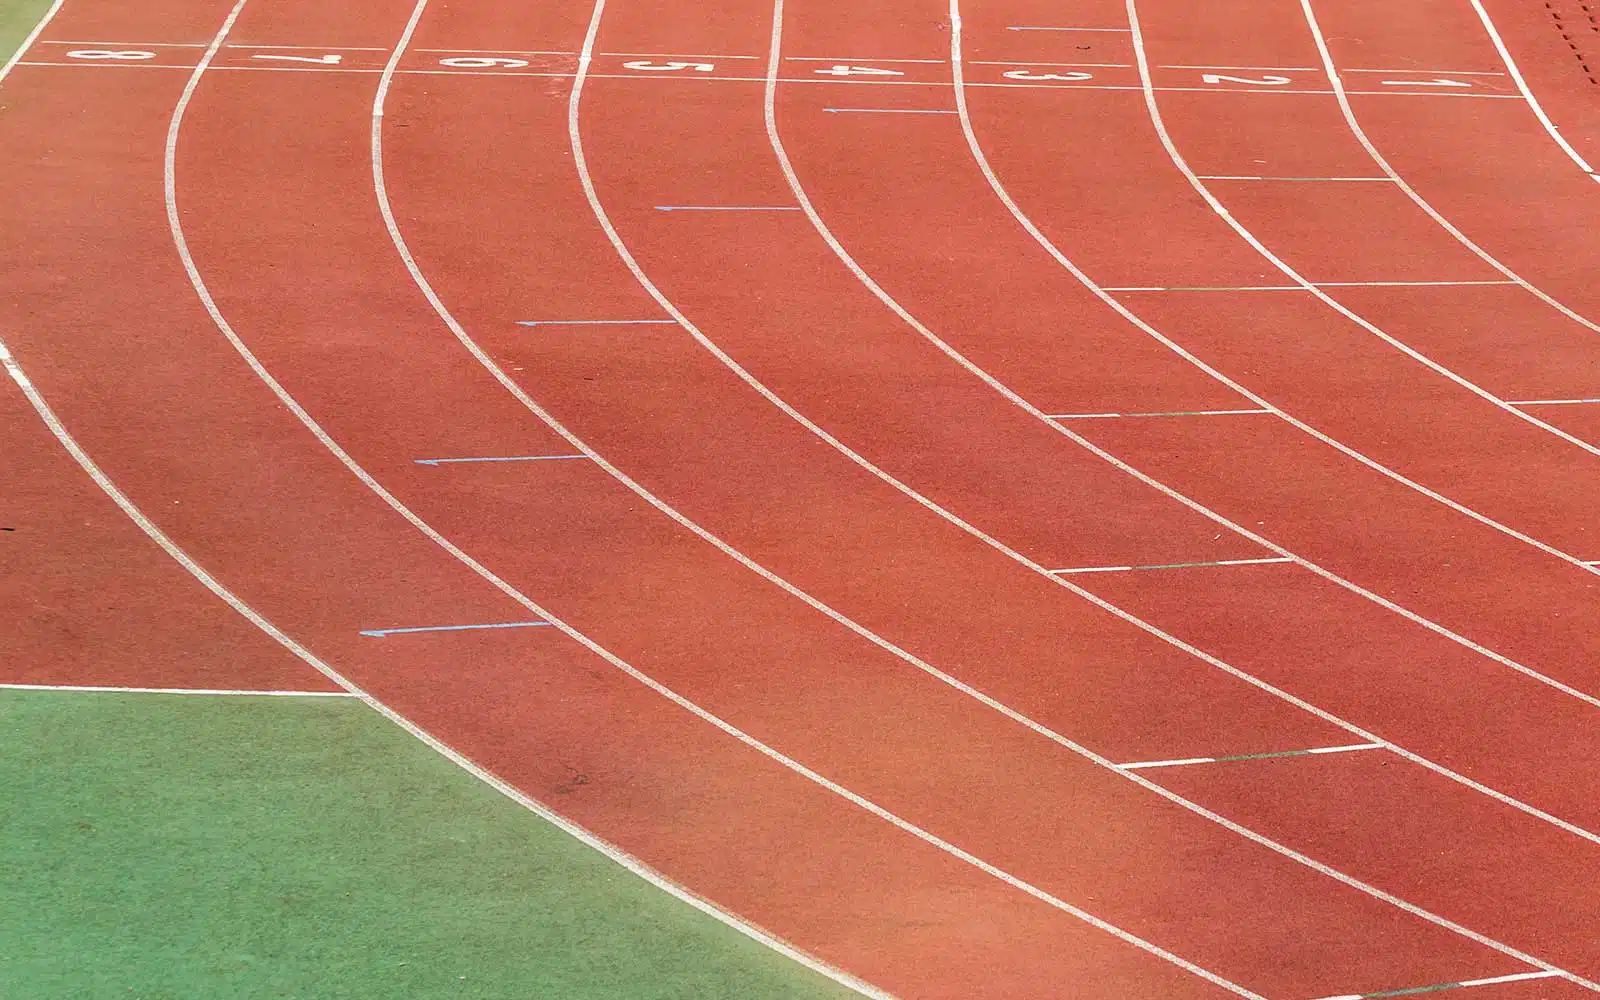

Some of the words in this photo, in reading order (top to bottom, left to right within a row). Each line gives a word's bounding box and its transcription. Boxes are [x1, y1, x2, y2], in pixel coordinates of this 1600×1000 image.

[66, 49, 156, 60] 8
[251, 54, 341, 64] 7
[438, 57, 529, 68] 6
[623, 60, 715, 72] 5
[813, 64, 904, 76] 4
[1003, 70, 1093, 81] 3
[1201, 73, 1292, 85] 2
[1380, 78, 1473, 88] 1
